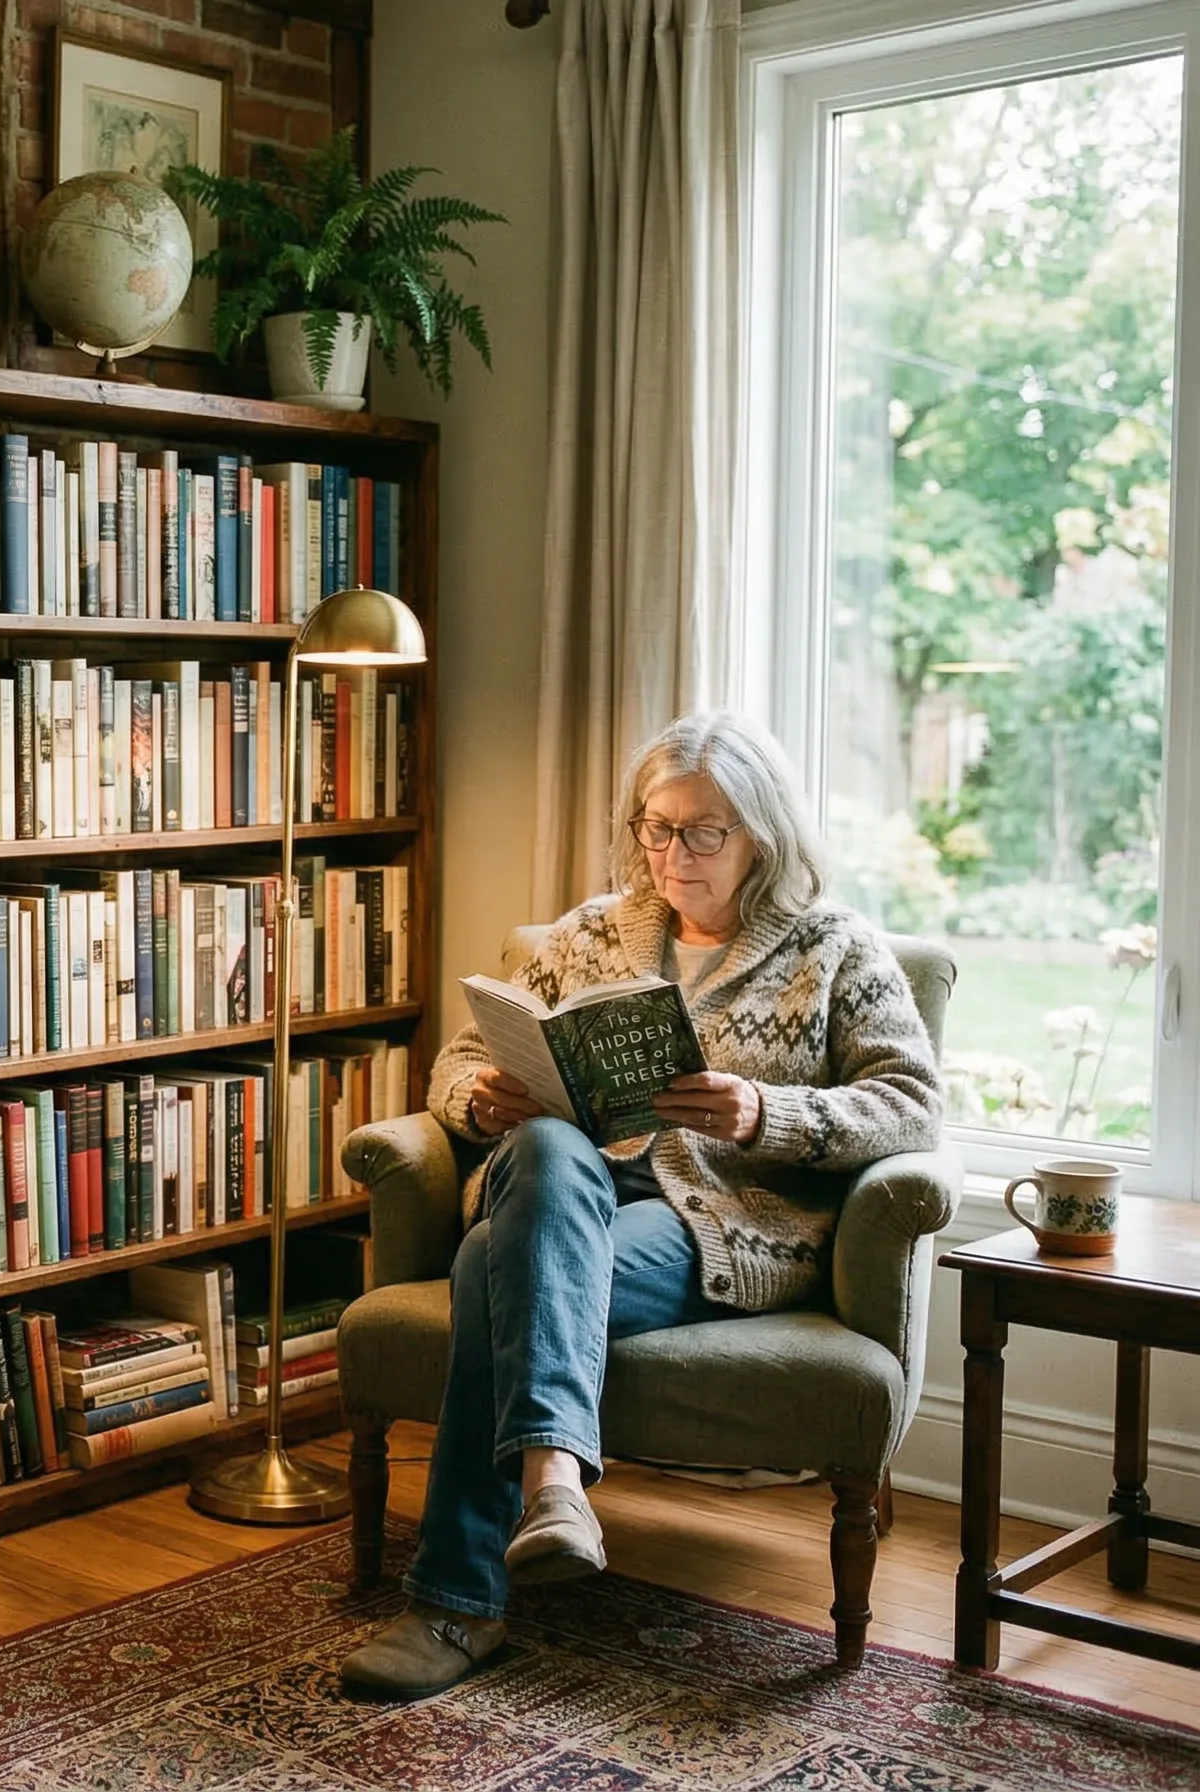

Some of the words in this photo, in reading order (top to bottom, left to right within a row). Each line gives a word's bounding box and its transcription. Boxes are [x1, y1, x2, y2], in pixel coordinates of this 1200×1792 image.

[607, 1012, 641, 1029] The
[590, 1022, 673, 1055] HIDDEN
[601, 1048, 646, 1070] LIFE
[653, 1042, 672, 1058] of
[610, 1061, 676, 1088] TREES
